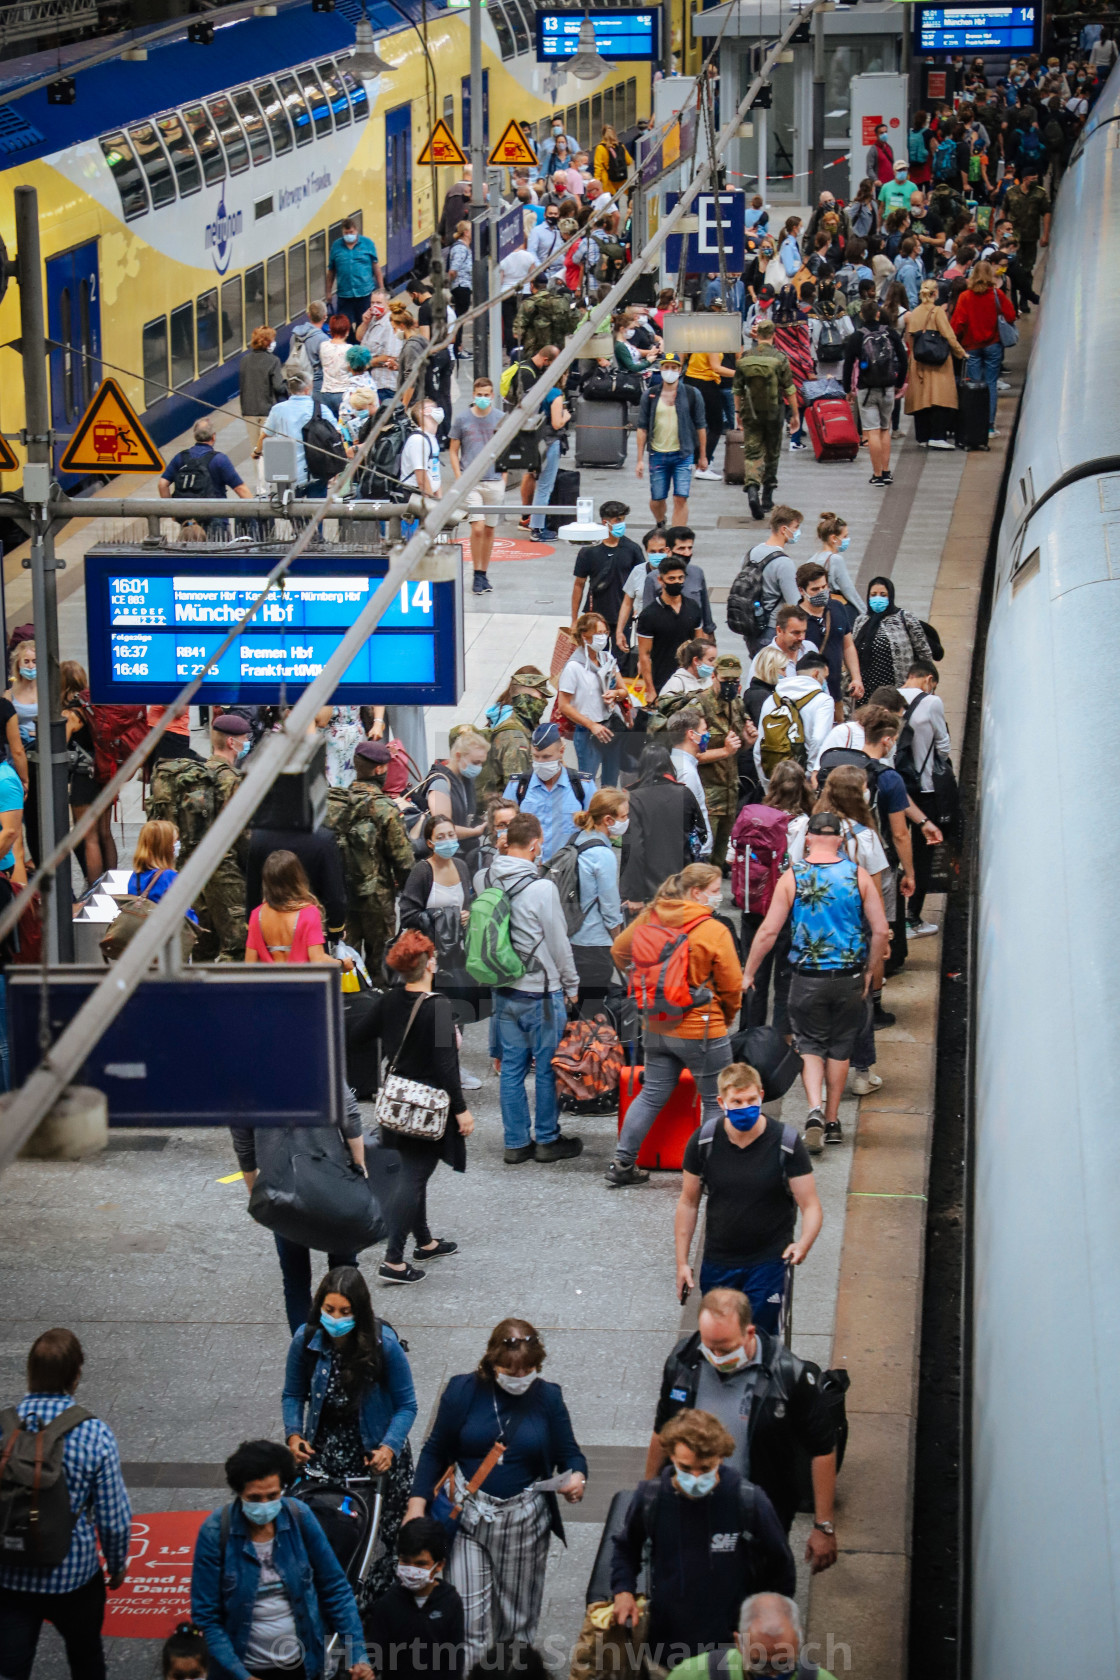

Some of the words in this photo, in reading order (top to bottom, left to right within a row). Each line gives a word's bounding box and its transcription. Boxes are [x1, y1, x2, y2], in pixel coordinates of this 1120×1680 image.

[1020, 8, 1034, 21] 14
[543, 17, 558, 30] 13
[698, 196, 733, 253] E
[89, 272, 96, 302] 2
[111, 579, 149, 594] 16:01
[111, 595, 126, 604] ICE
[174, 591, 218, 601] Hannover
[219, 591, 237, 601] Hbf
[300, 591, 344, 603] Nürnberg
[344, 591, 361, 601] Hbf
[400, 580, 433, 614] 14
[263, 604, 294, 622] Hbf
[112, 645, 148, 658] 16:37
[176, 646, 206, 658] RB41
[240, 646, 287, 659] Bremen
[290, 646, 314, 659] Hbf
[113, 663, 149, 676] 16:46
[177, 664, 189, 676] IC
[110, 1606, 171, 1615] Thank
